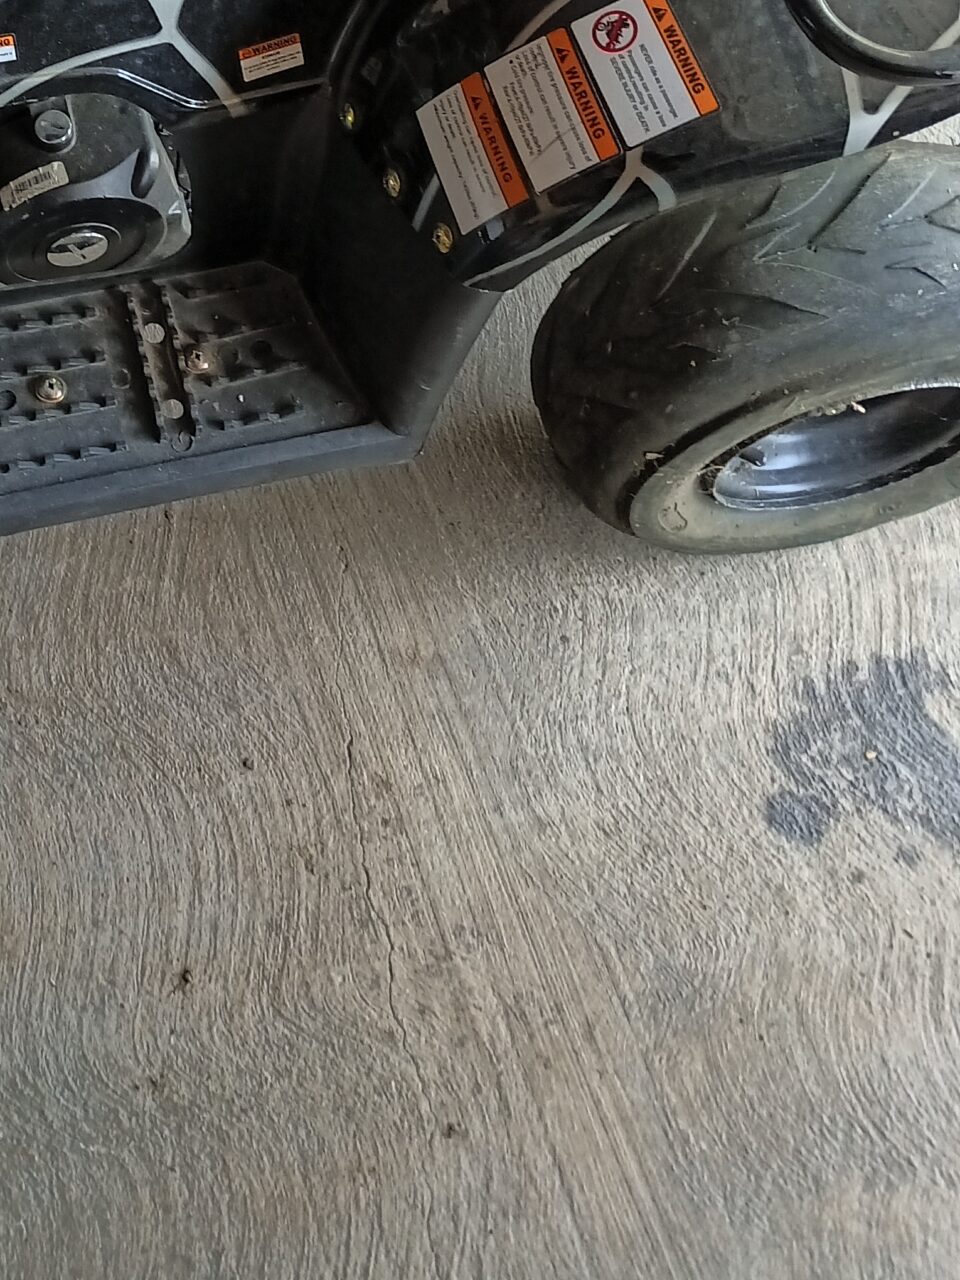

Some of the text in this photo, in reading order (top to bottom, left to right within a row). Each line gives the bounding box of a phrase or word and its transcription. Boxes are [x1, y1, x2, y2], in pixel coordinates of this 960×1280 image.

[661, 24, 706, 95] WARNING
[564, 64, 606, 141] WARNING
[478, 110, 513, 185] WARNING
